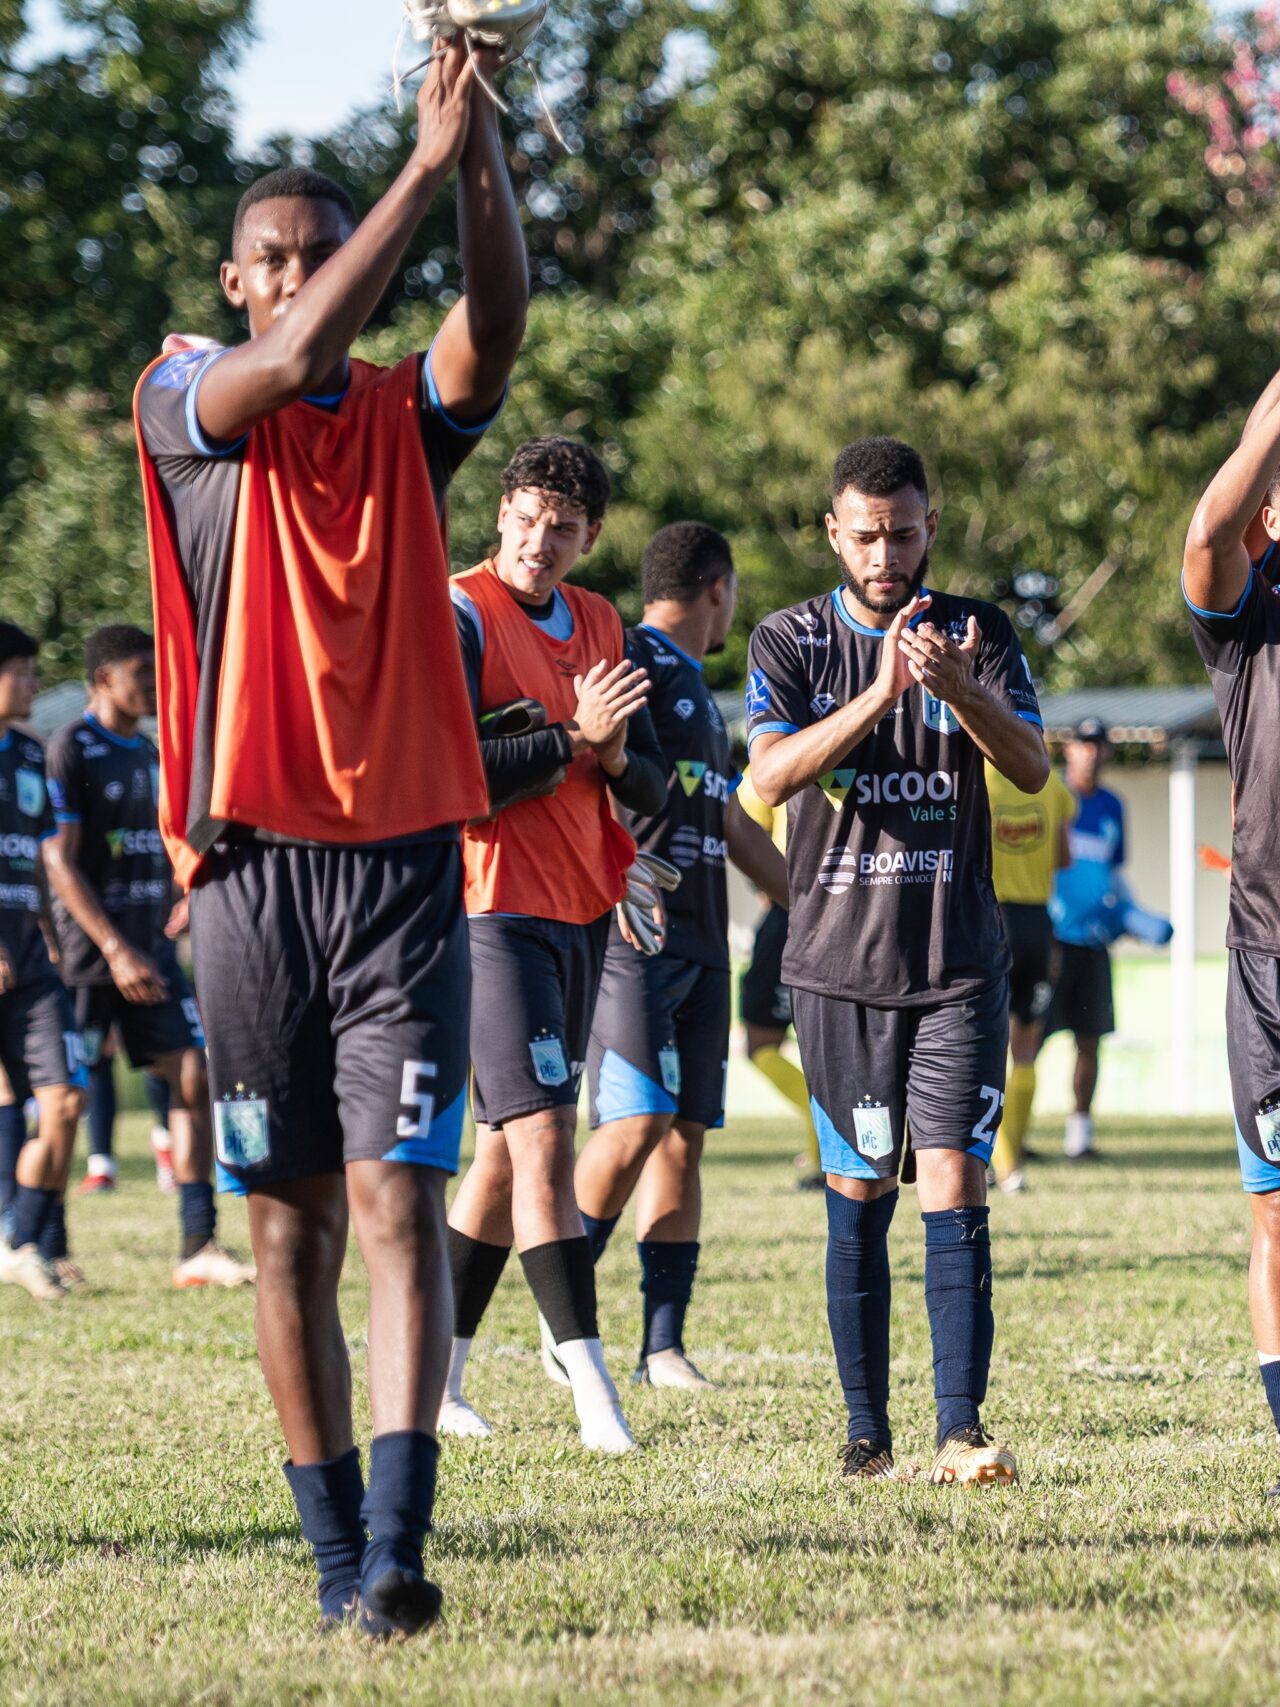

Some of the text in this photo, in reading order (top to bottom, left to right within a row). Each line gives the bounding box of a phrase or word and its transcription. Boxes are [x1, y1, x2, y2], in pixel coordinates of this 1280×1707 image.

[856, 770, 959, 804] SICOO
[910, 805, 944, 822] Vale
[860, 849, 953, 874] BOAVIST
[860, 875, 893, 886] SEMPRE
[895, 874, 914, 885] COM
[396, 1059, 437, 1139] 5
[971, 1084, 1005, 1147] 2
